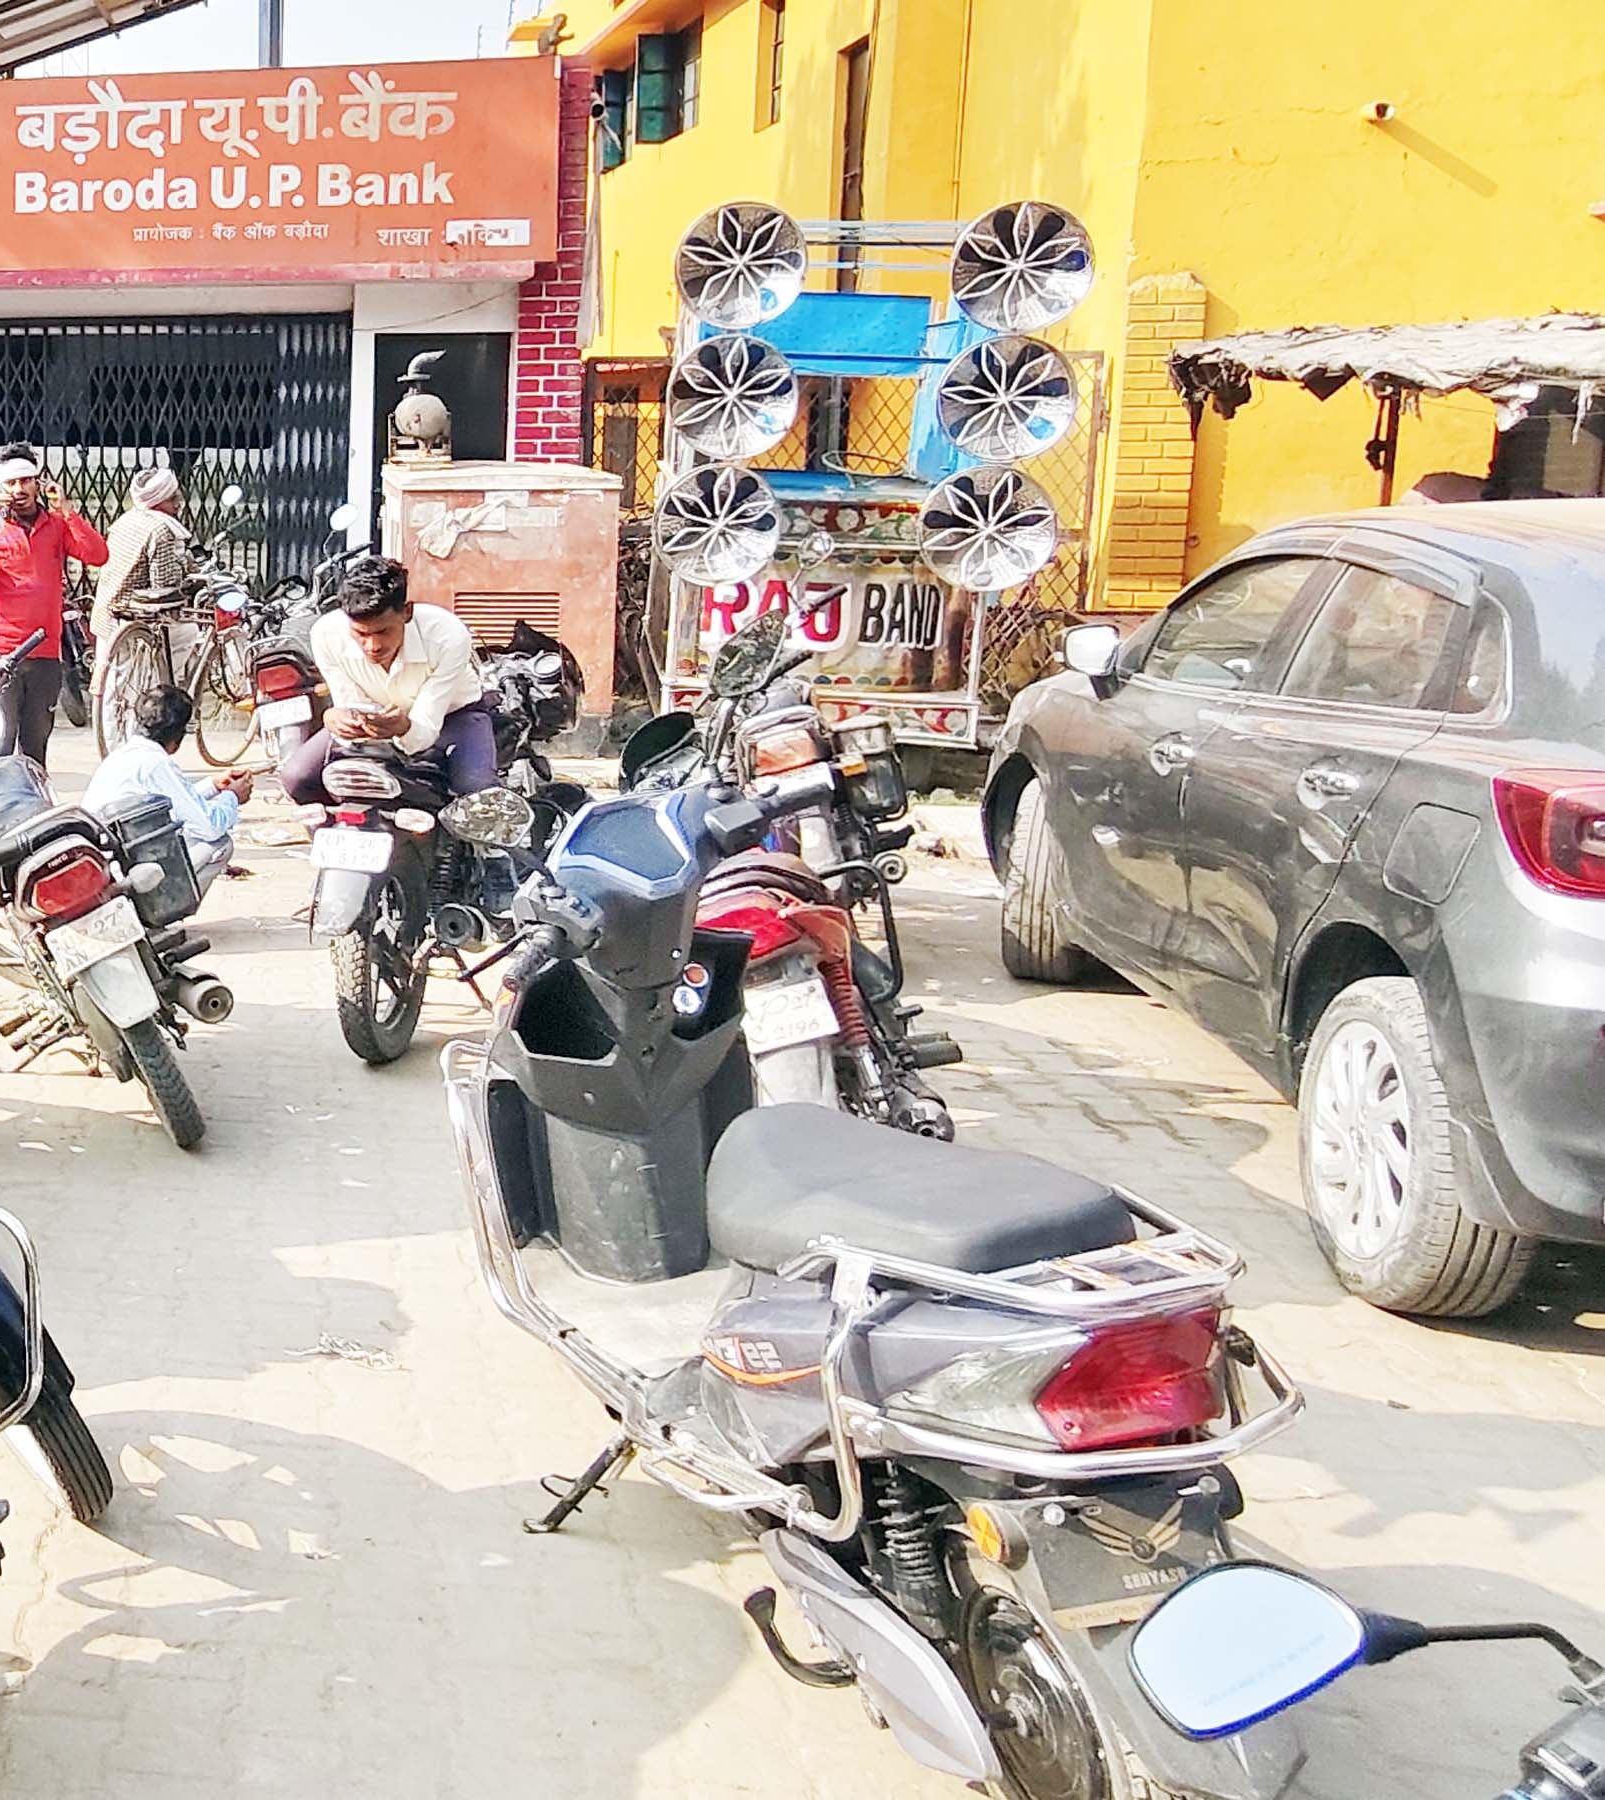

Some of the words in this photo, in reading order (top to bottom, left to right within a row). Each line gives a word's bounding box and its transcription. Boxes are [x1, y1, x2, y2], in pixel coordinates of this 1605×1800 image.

[15, 80, 187, 165] बड़ौदा
[339, 70, 458, 142] बैंक
[15, 168, 197, 213] Baroda
[210, 165, 304, 209] U.P.
[317, 161, 454, 206] Bank
[132, 223, 193, 242] प्रायोजक
[243, 222, 277, 240] ऑफ
[376, 228, 432, 247] शाखा
[857, 582, 942, 649] BAND
[94, 911, 118, 936] 27
